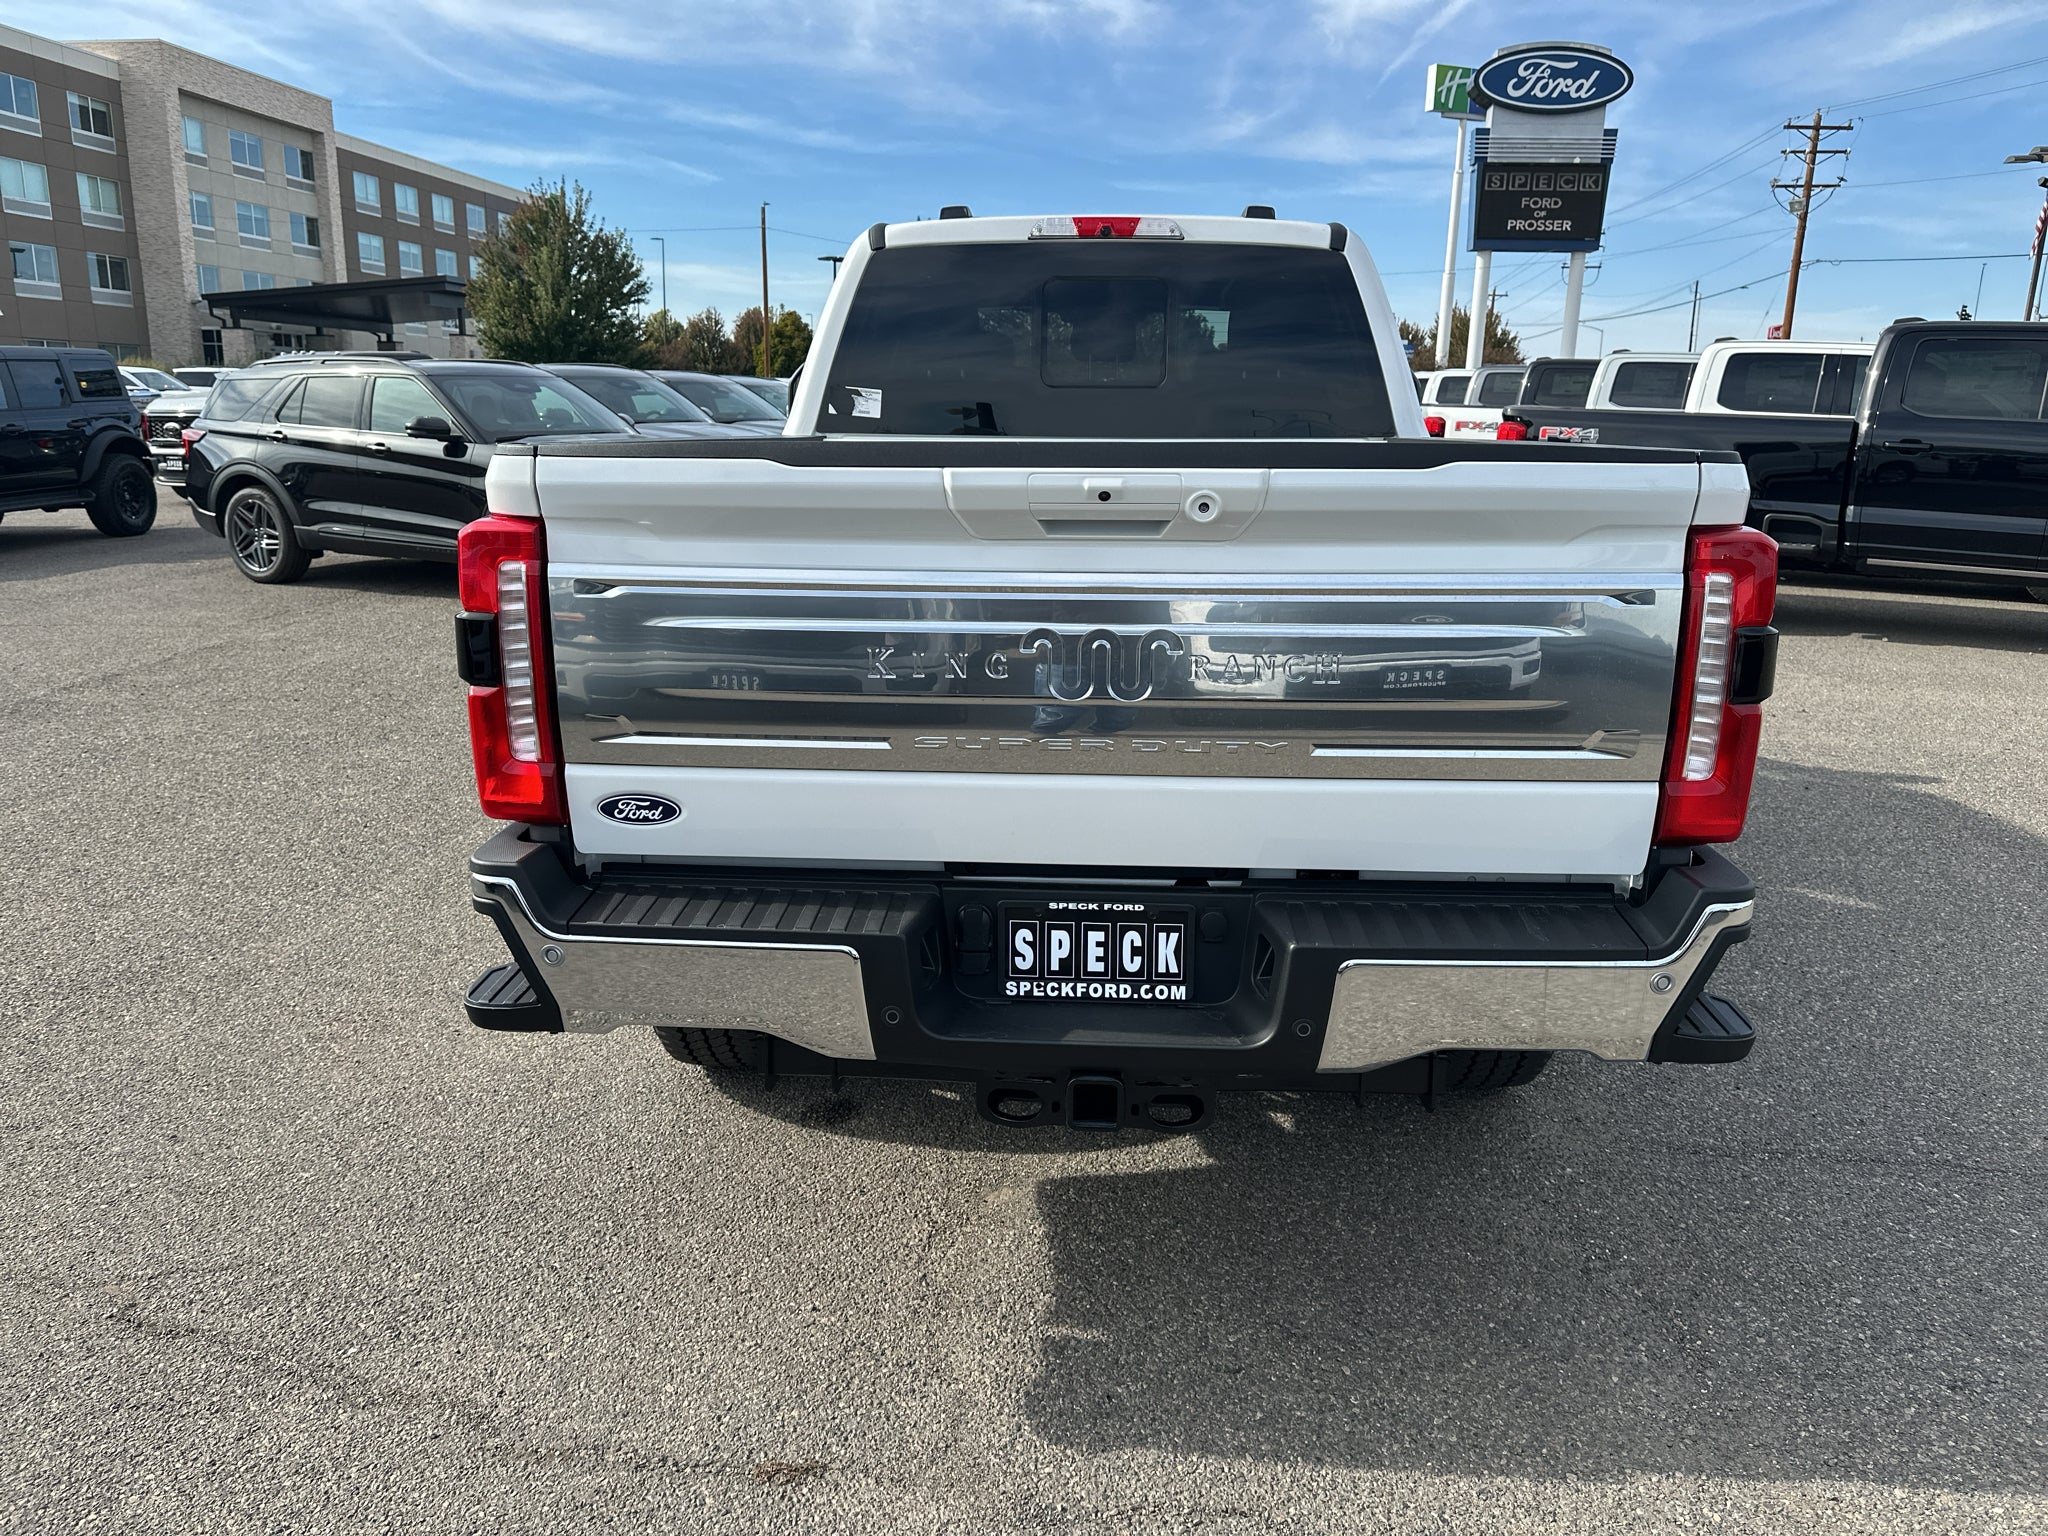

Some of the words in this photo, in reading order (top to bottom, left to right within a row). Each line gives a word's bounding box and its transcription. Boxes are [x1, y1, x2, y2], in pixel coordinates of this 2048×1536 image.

[1506, 58, 1600, 99] Ford
[1490, 175, 1598, 189] SPECK
[1521, 197, 1562, 209] FORD
[1534, 210, 1547, 218] OF
[1507, 219, 1572, 231] PROSSER
[1455, 421, 1499, 432] FX4
[1538, 425, 1600, 442] FX4
[866, 647, 1009, 679] KING
[1187, 651, 1343, 685] RANCH
[914, 736, 1114, 752] SUPER
[1131, 738, 1289, 754] DUTY
[613, 799, 664, 820] Ford
[1048, 902, 1100, 910] SPECK
[1103, 903, 1145, 911] FORD
[1014, 928, 1180, 974] SPECK
[1005, 981, 1187, 1000] SPECKFORD.COM
